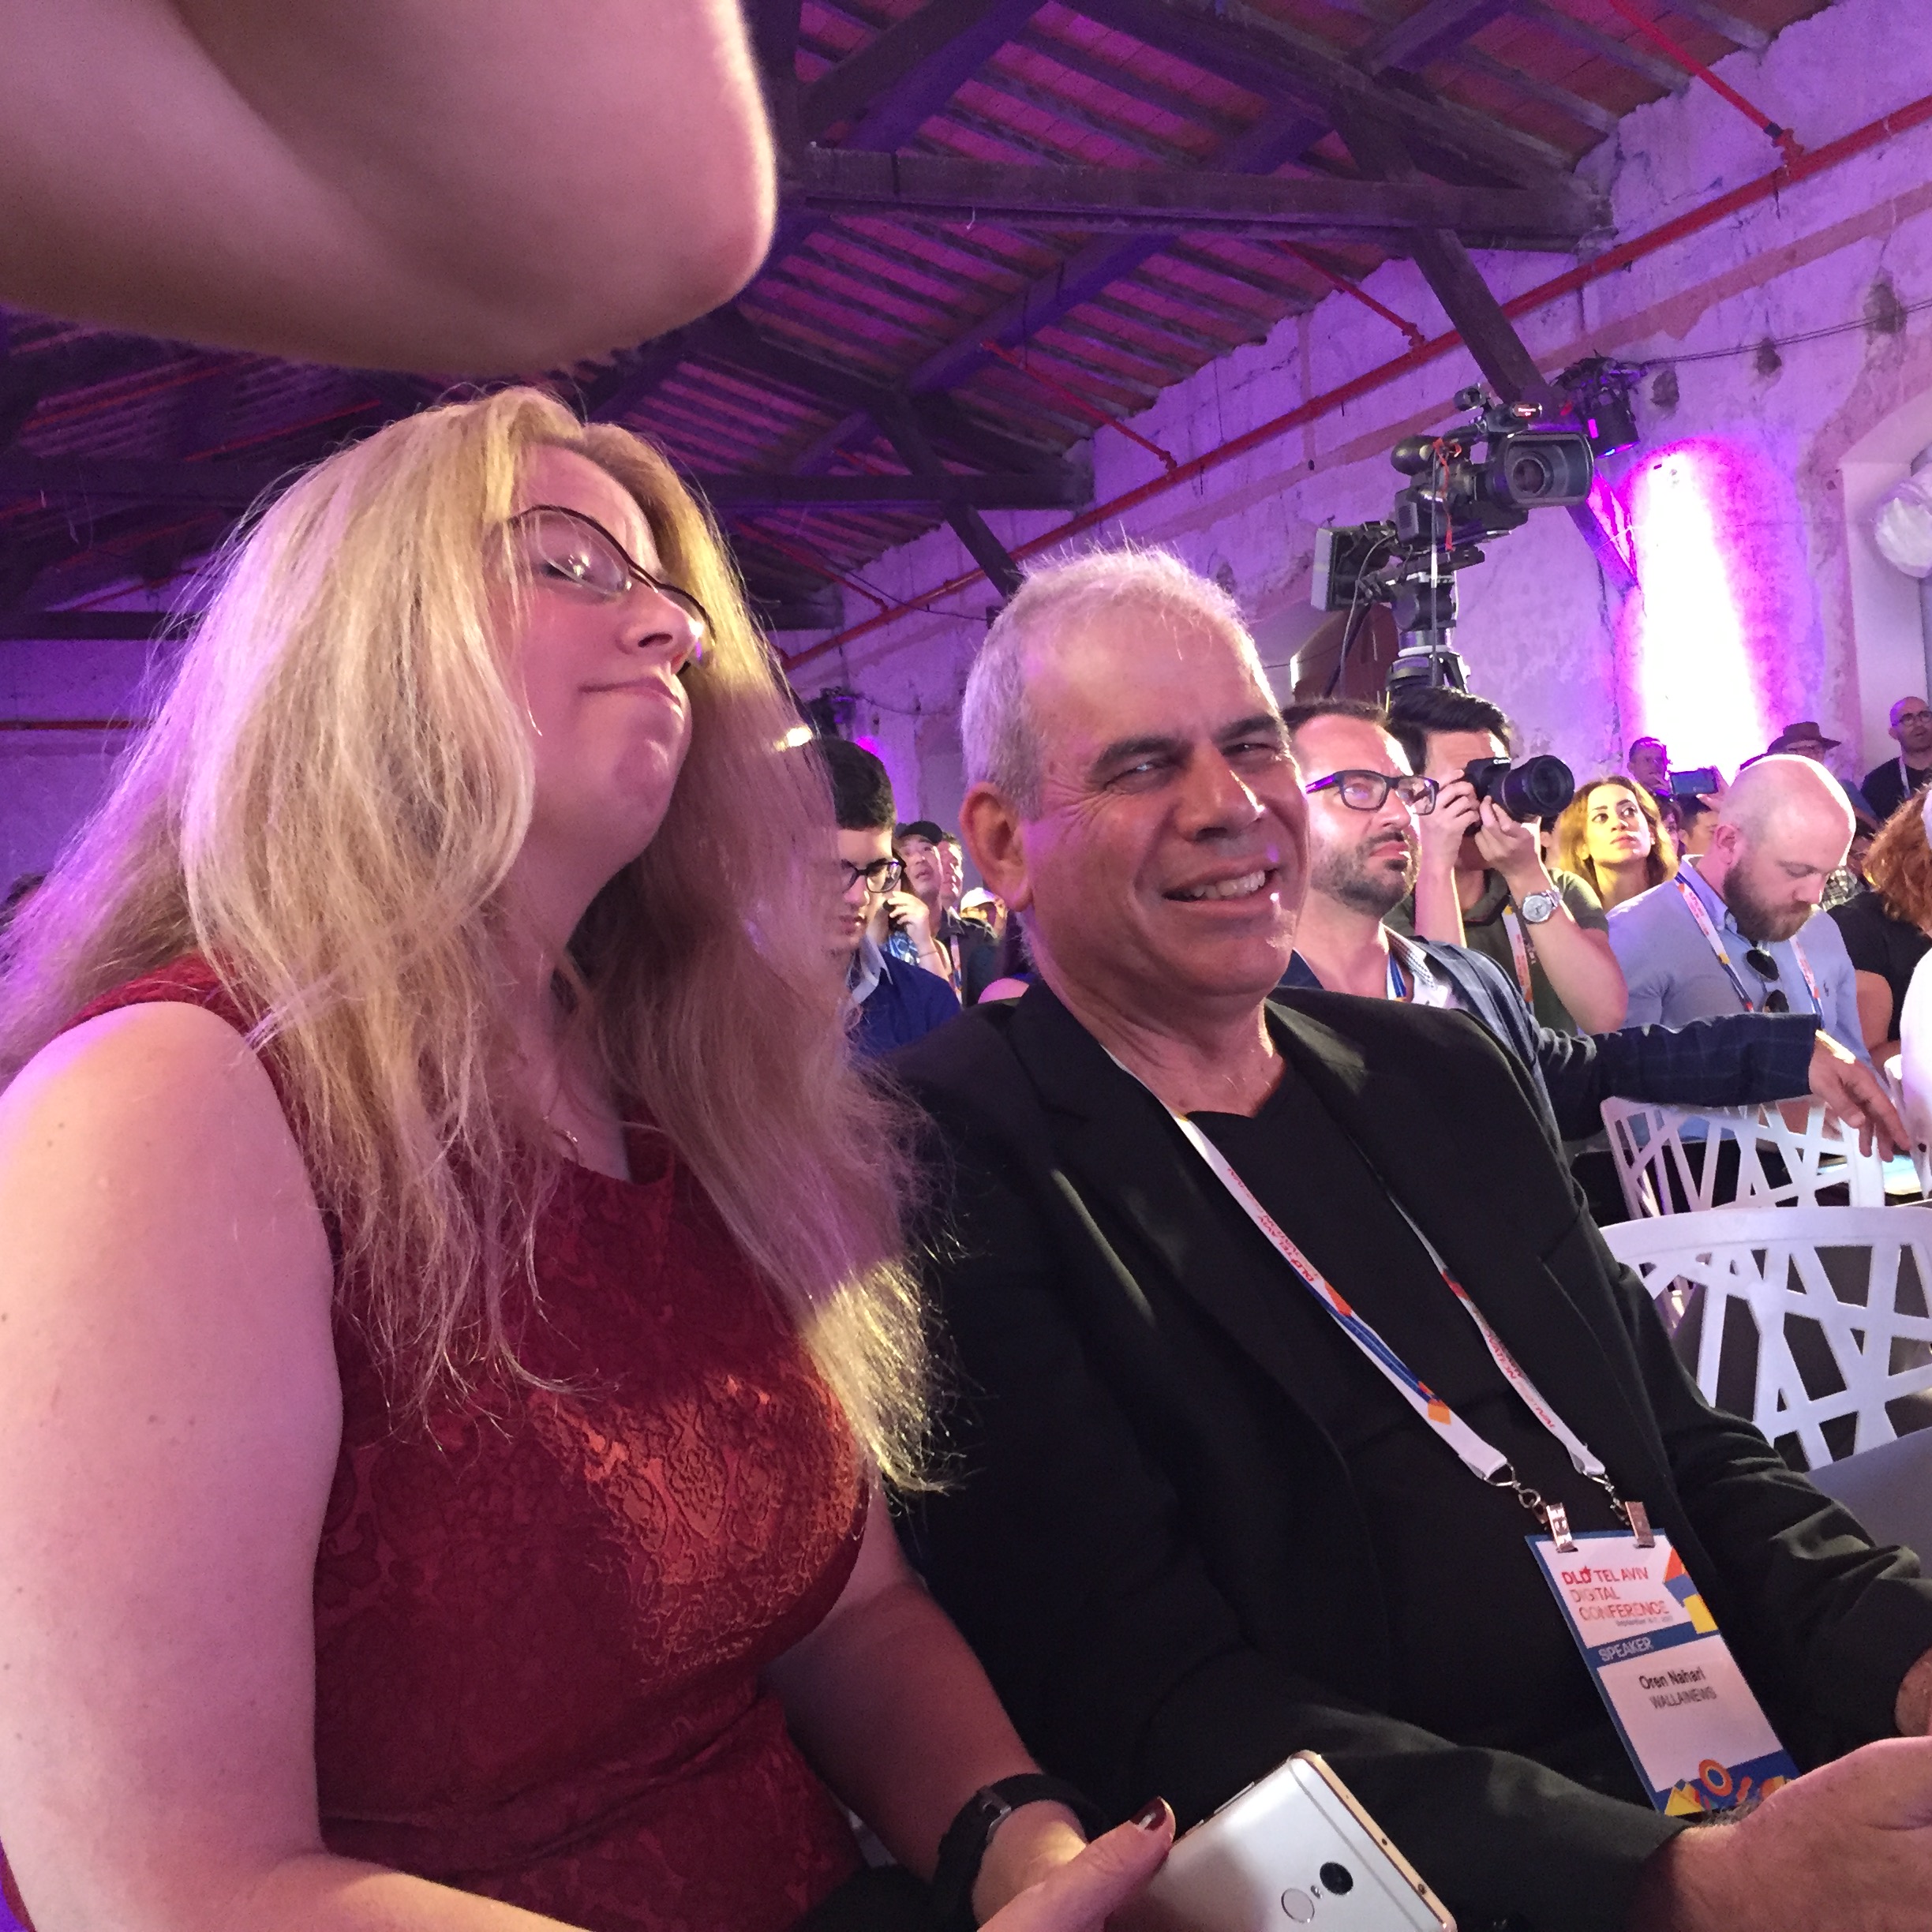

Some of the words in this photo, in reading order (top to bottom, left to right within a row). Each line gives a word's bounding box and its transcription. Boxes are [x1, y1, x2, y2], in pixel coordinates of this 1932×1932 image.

[1593, 1568, 1620, 1582] TEL
[1620, 1567, 1649, 1581] AVIV
[1569, 1586, 1620, 1603] DIGITAL
[1578, 1600, 1669, 1621] CONFERENCE
[1598, 1636, 1654, 1662] SPEAKER
[1638, 1675, 1670, 1690] Oren
